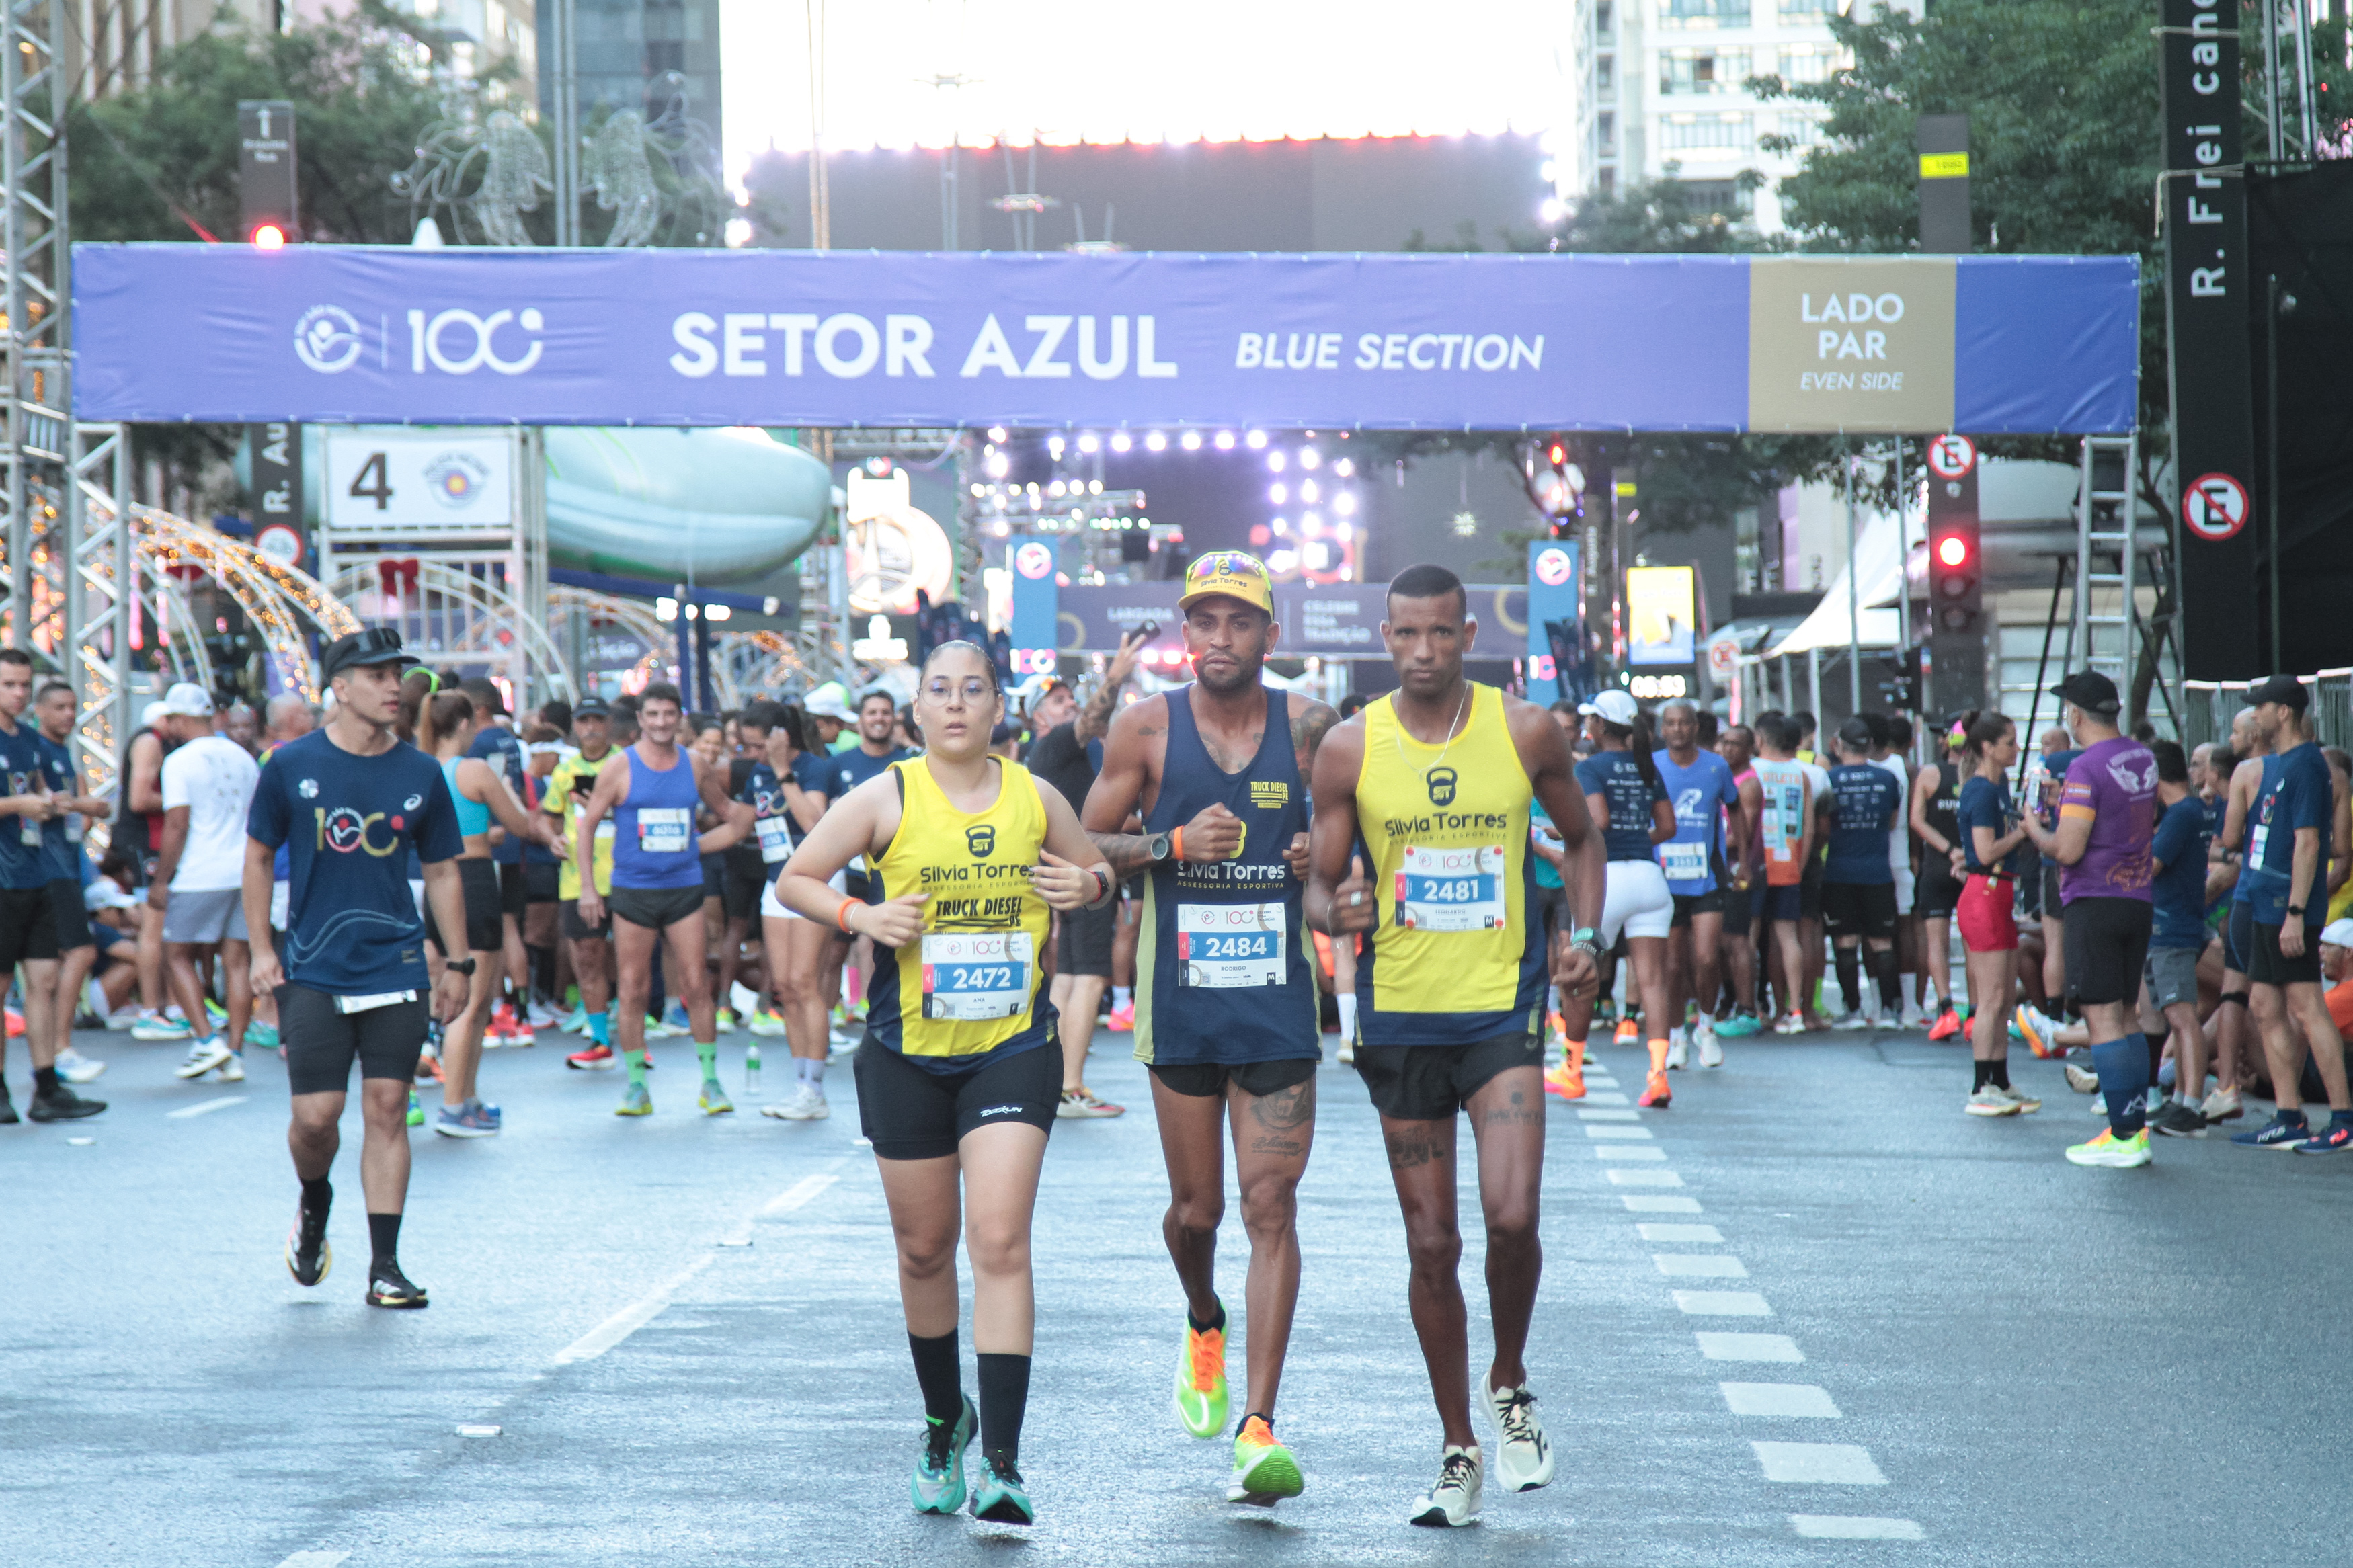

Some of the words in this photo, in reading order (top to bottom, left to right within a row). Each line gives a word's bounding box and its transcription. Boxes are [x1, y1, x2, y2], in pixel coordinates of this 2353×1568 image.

[2186, 124, 2223, 224] Frei
[2190, 247, 2226, 297] R.
[1802, 293, 1905, 323] LADO
[670, 311, 936, 378] SETOR
[959, 312, 1178, 380] AZUL
[1235, 331, 1343, 370] BLUE
[1354, 333, 1545, 372] SECTION
[1818, 330, 1886, 359] PAR
[1800, 372, 1854, 390] EVEN
[1860, 371, 1904, 391] SIDE
[350, 452, 393, 509] 4
[262, 480, 292, 513] R.
[2203, 487, 2230, 525] E
[1219, 578, 1248, 587] Torres
[1251, 781, 1269, 792] TRUCK
[1271, 781, 1288, 792] DIESEL
[1384, 815, 1430, 837] Silvia
[1433, 811, 1507, 829] Torres
[920, 864, 968, 883] Silvia
[1221, 862, 1285, 880] Torres
[1177, 880, 1231, 889] ASSESSORIA
[1423, 879, 1478, 902] 2481
[936, 898, 979, 916] TRUCK
[984, 896, 1022, 915] DIESEL
[1206, 937, 1267, 957] 2484
[953, 967, 1011, 989] 2472
